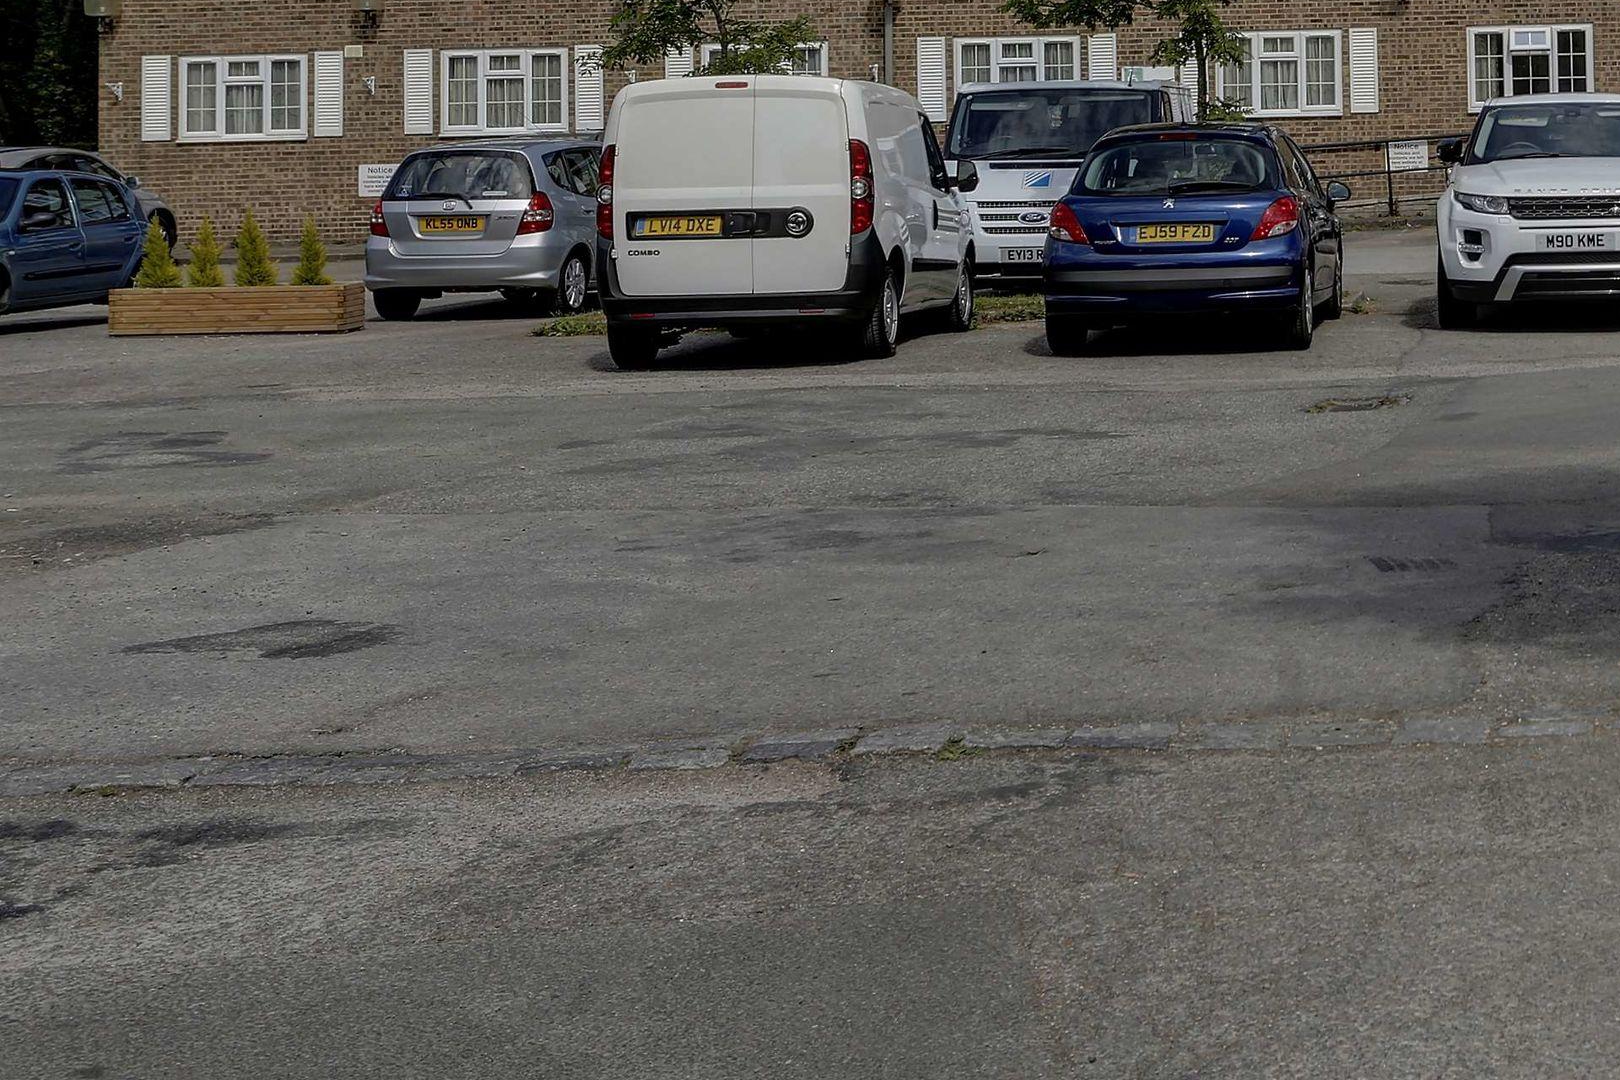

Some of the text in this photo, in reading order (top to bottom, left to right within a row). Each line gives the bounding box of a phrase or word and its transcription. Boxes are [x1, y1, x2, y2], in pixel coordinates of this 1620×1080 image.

[367, 166, 393, 174] Notice
[425, 218, 454, 230] KL55
[649, 218, 716, 233] LV14 DXE
[1139, 225, 1211, 239] EJ59 FZD
[1546, 233, 1605, 248] M90 KME
[627, 249, 661, 257] COMBO
[1007, 249, 1034, 261] EY13
